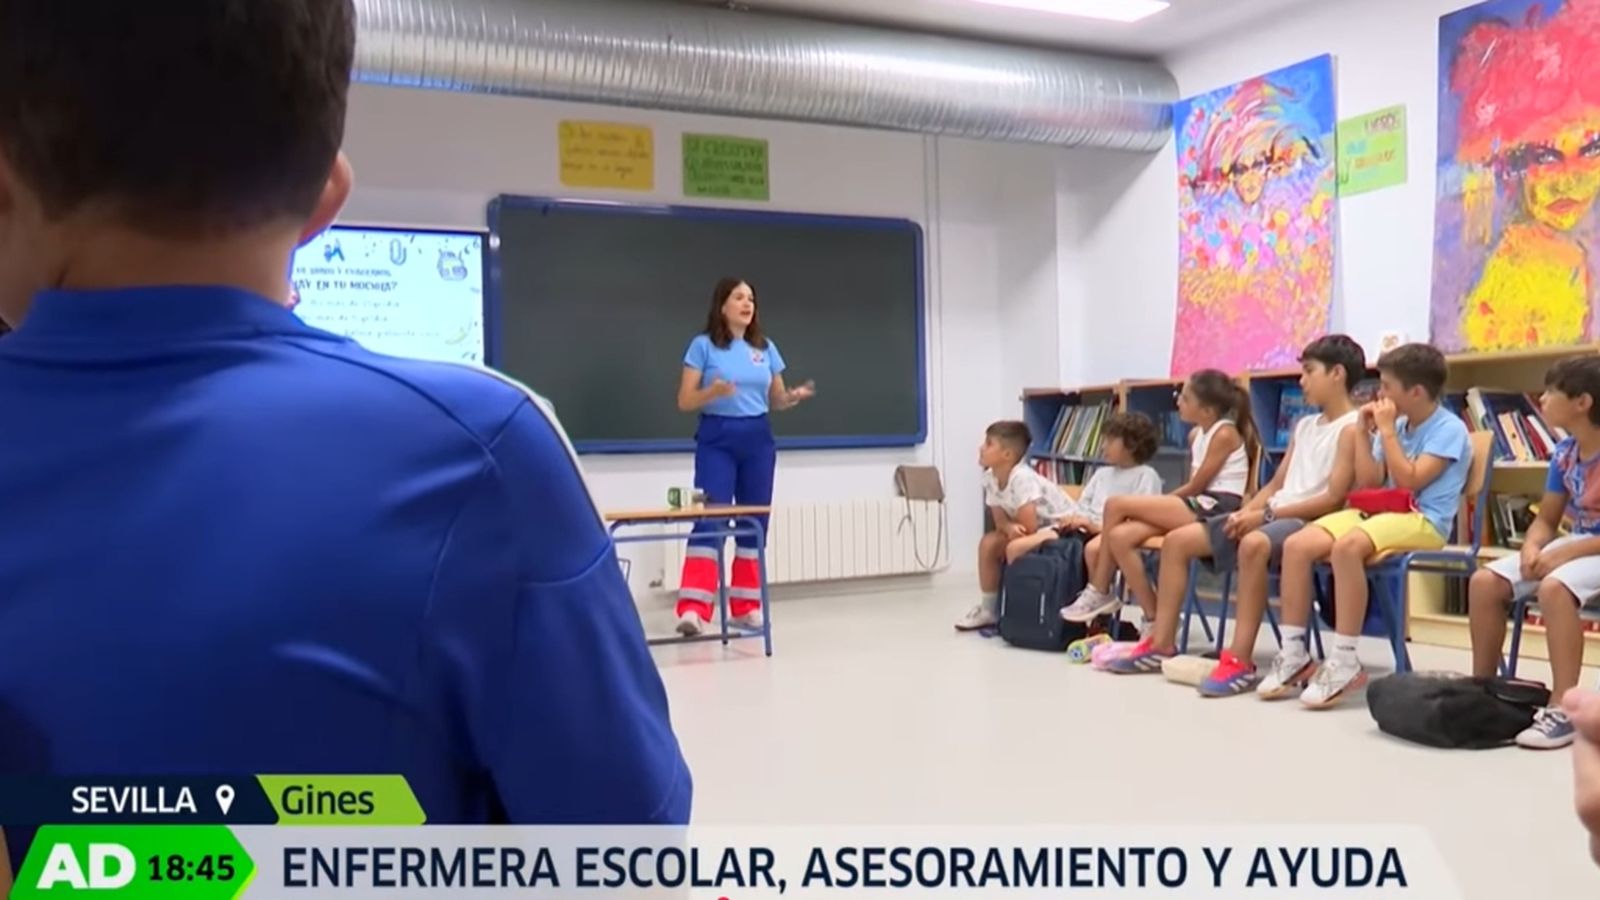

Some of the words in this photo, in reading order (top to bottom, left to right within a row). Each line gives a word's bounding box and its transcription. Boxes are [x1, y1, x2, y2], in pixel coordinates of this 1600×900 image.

[316, 280, 330, 291] EN
[334, 280, 348, 290] TU
[350, 280, 398, 293] MOCHILA?
